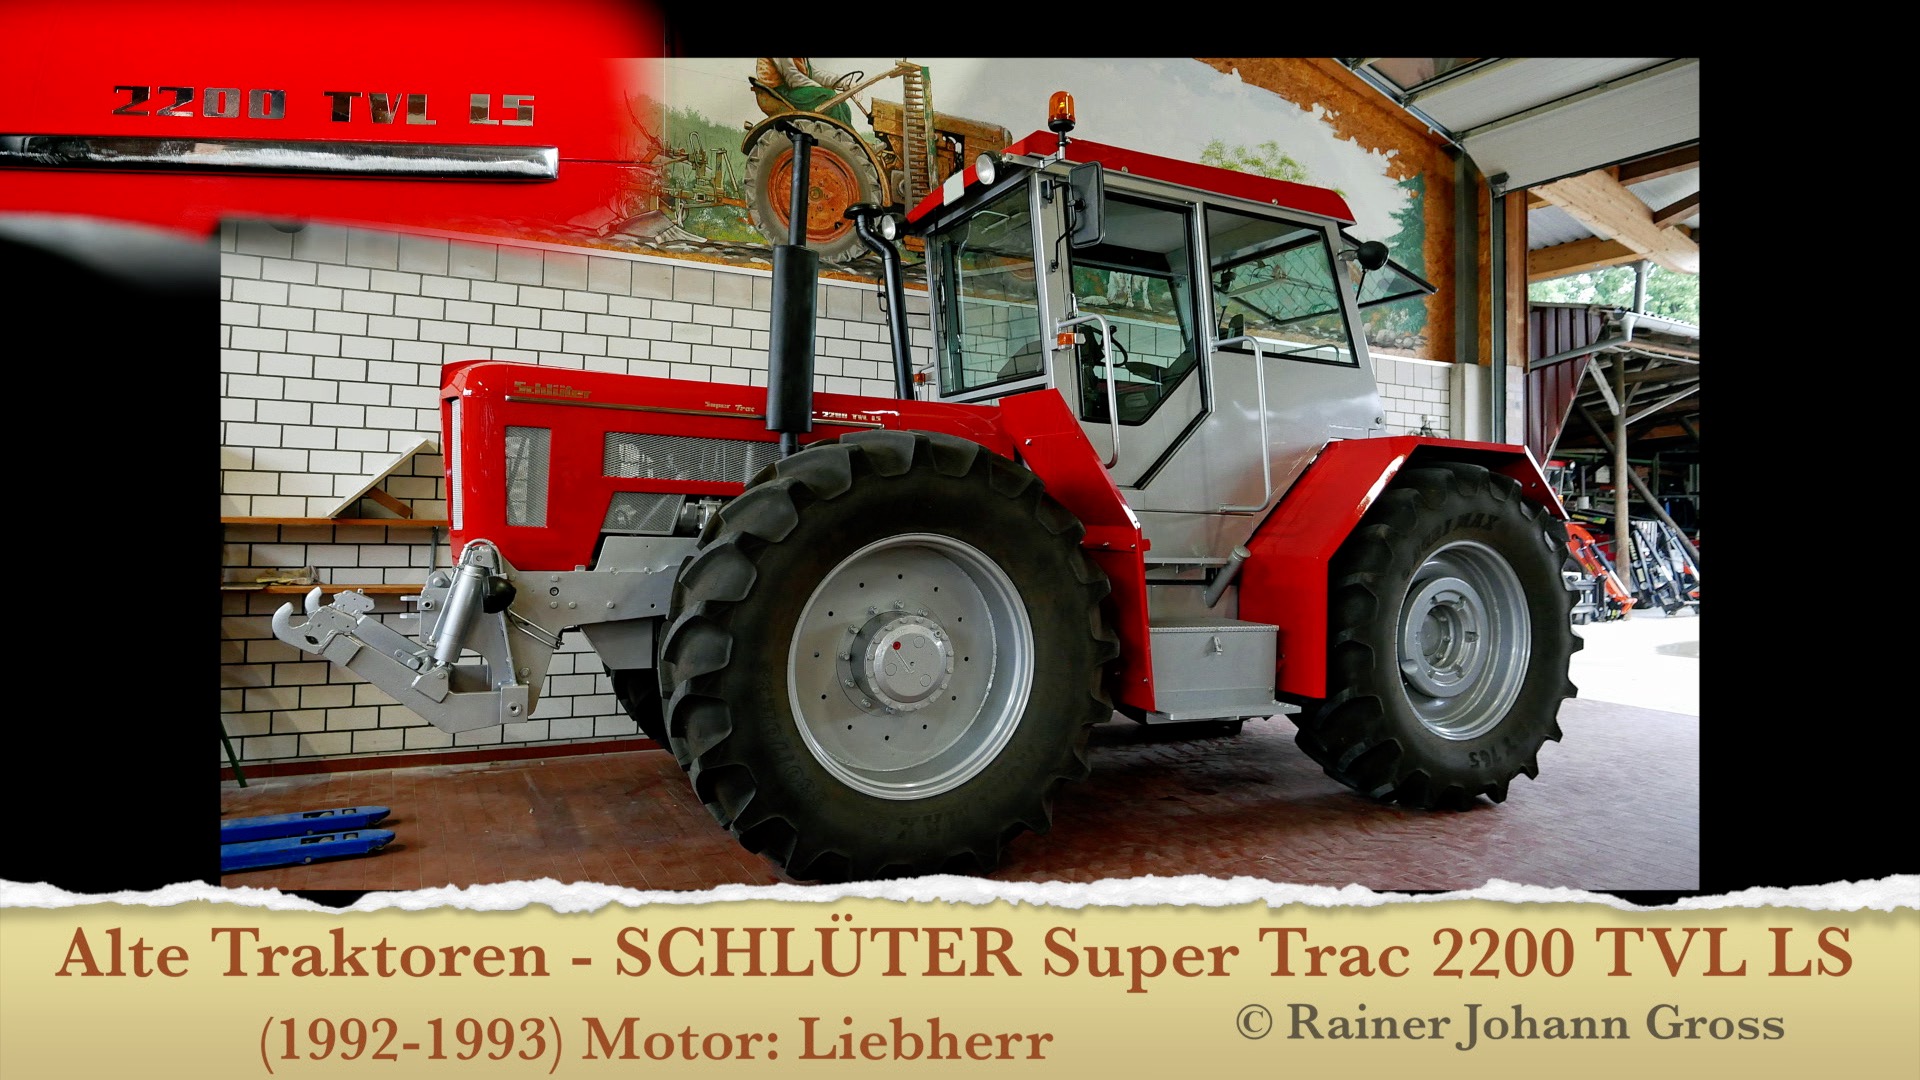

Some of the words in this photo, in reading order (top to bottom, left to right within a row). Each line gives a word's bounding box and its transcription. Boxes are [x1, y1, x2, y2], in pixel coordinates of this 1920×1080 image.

[112, 86, 286, 119] 2200
[322, 90, 437, 125] TVL
[469, 93, 535, 126] LS
[513, 380, 592, 399] Schlüter
[704, 401, 731, 410] Super
[735, 404, 756, 412] Trac
[822, 411, 848, 419] 2200
